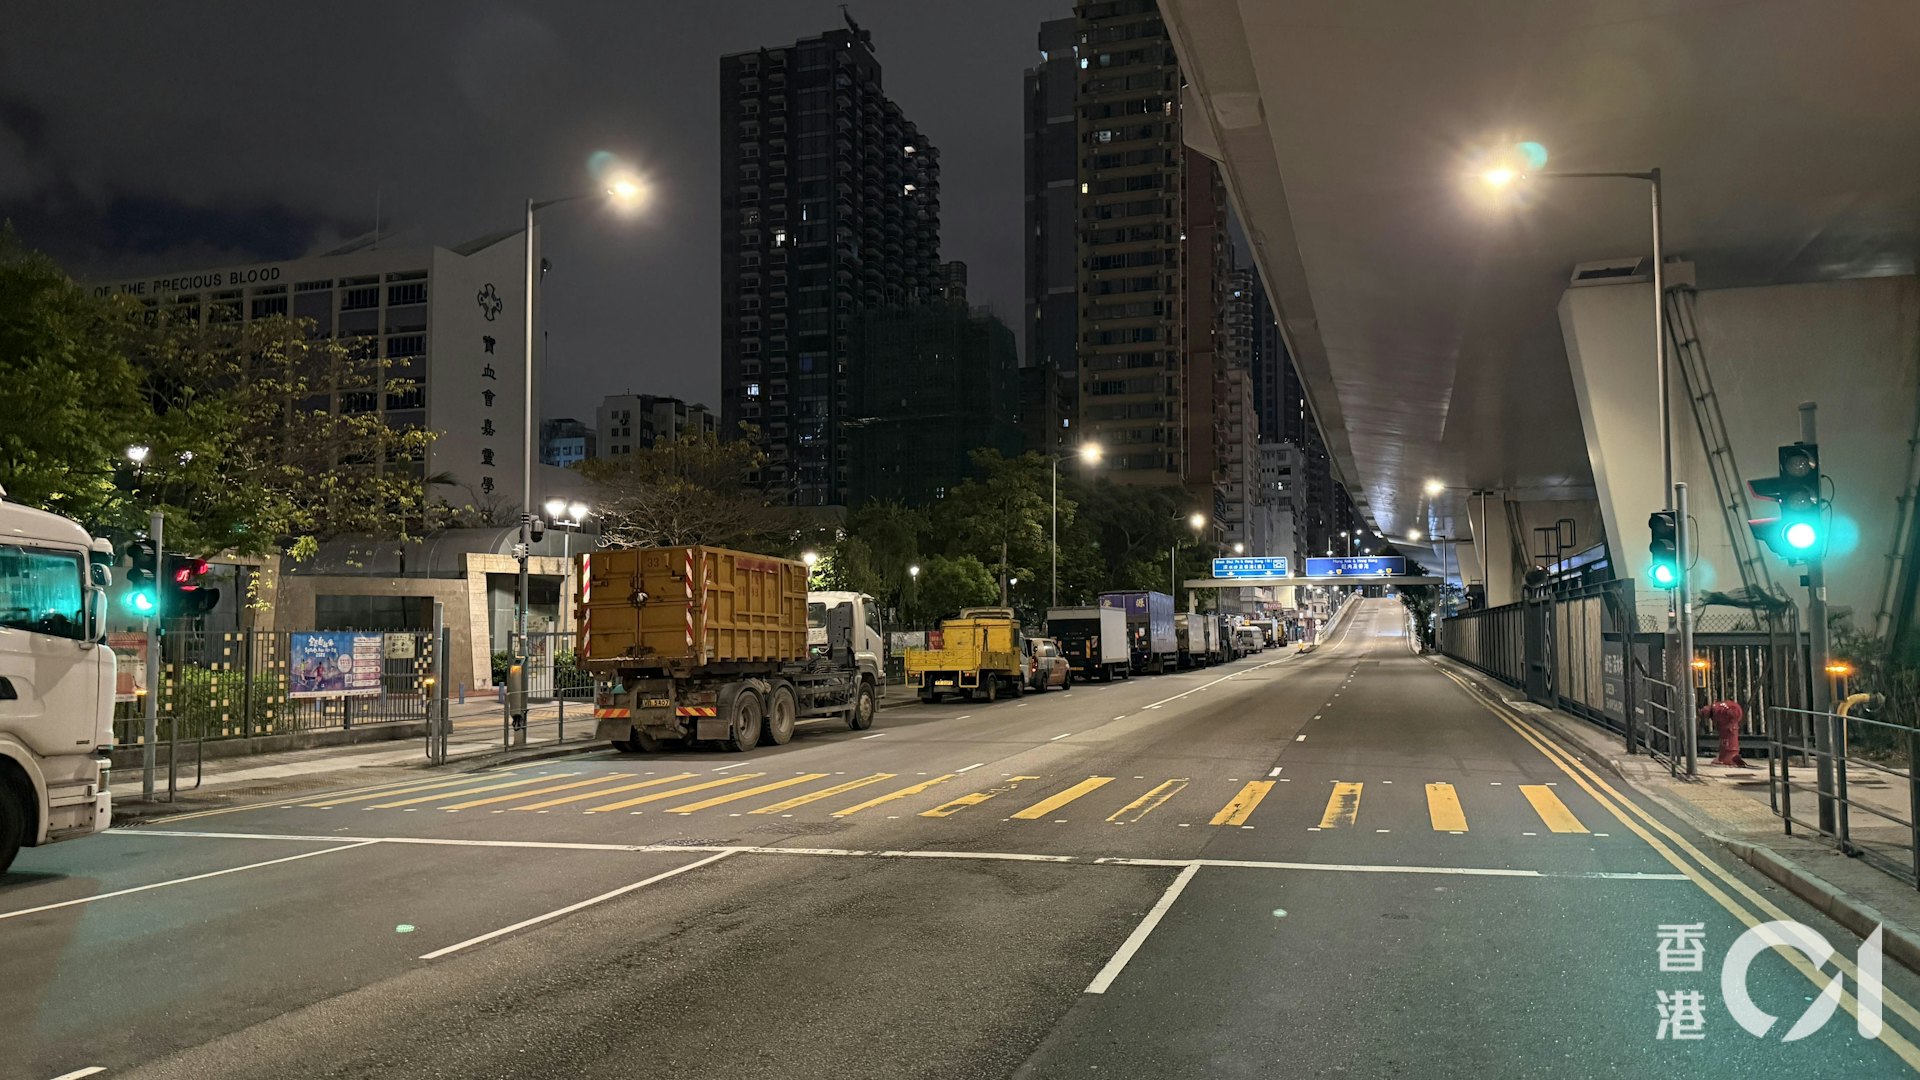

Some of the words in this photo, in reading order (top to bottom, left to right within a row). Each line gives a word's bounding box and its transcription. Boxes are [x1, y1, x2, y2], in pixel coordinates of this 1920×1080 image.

[94, 286, 111, 297] OF
[121, 282, 145, 295] THE
[153, 274, 222, 293] PRECIOUS
[230, 267, 280, 285] BLOOD
[647, 557, 660, 568] 33
